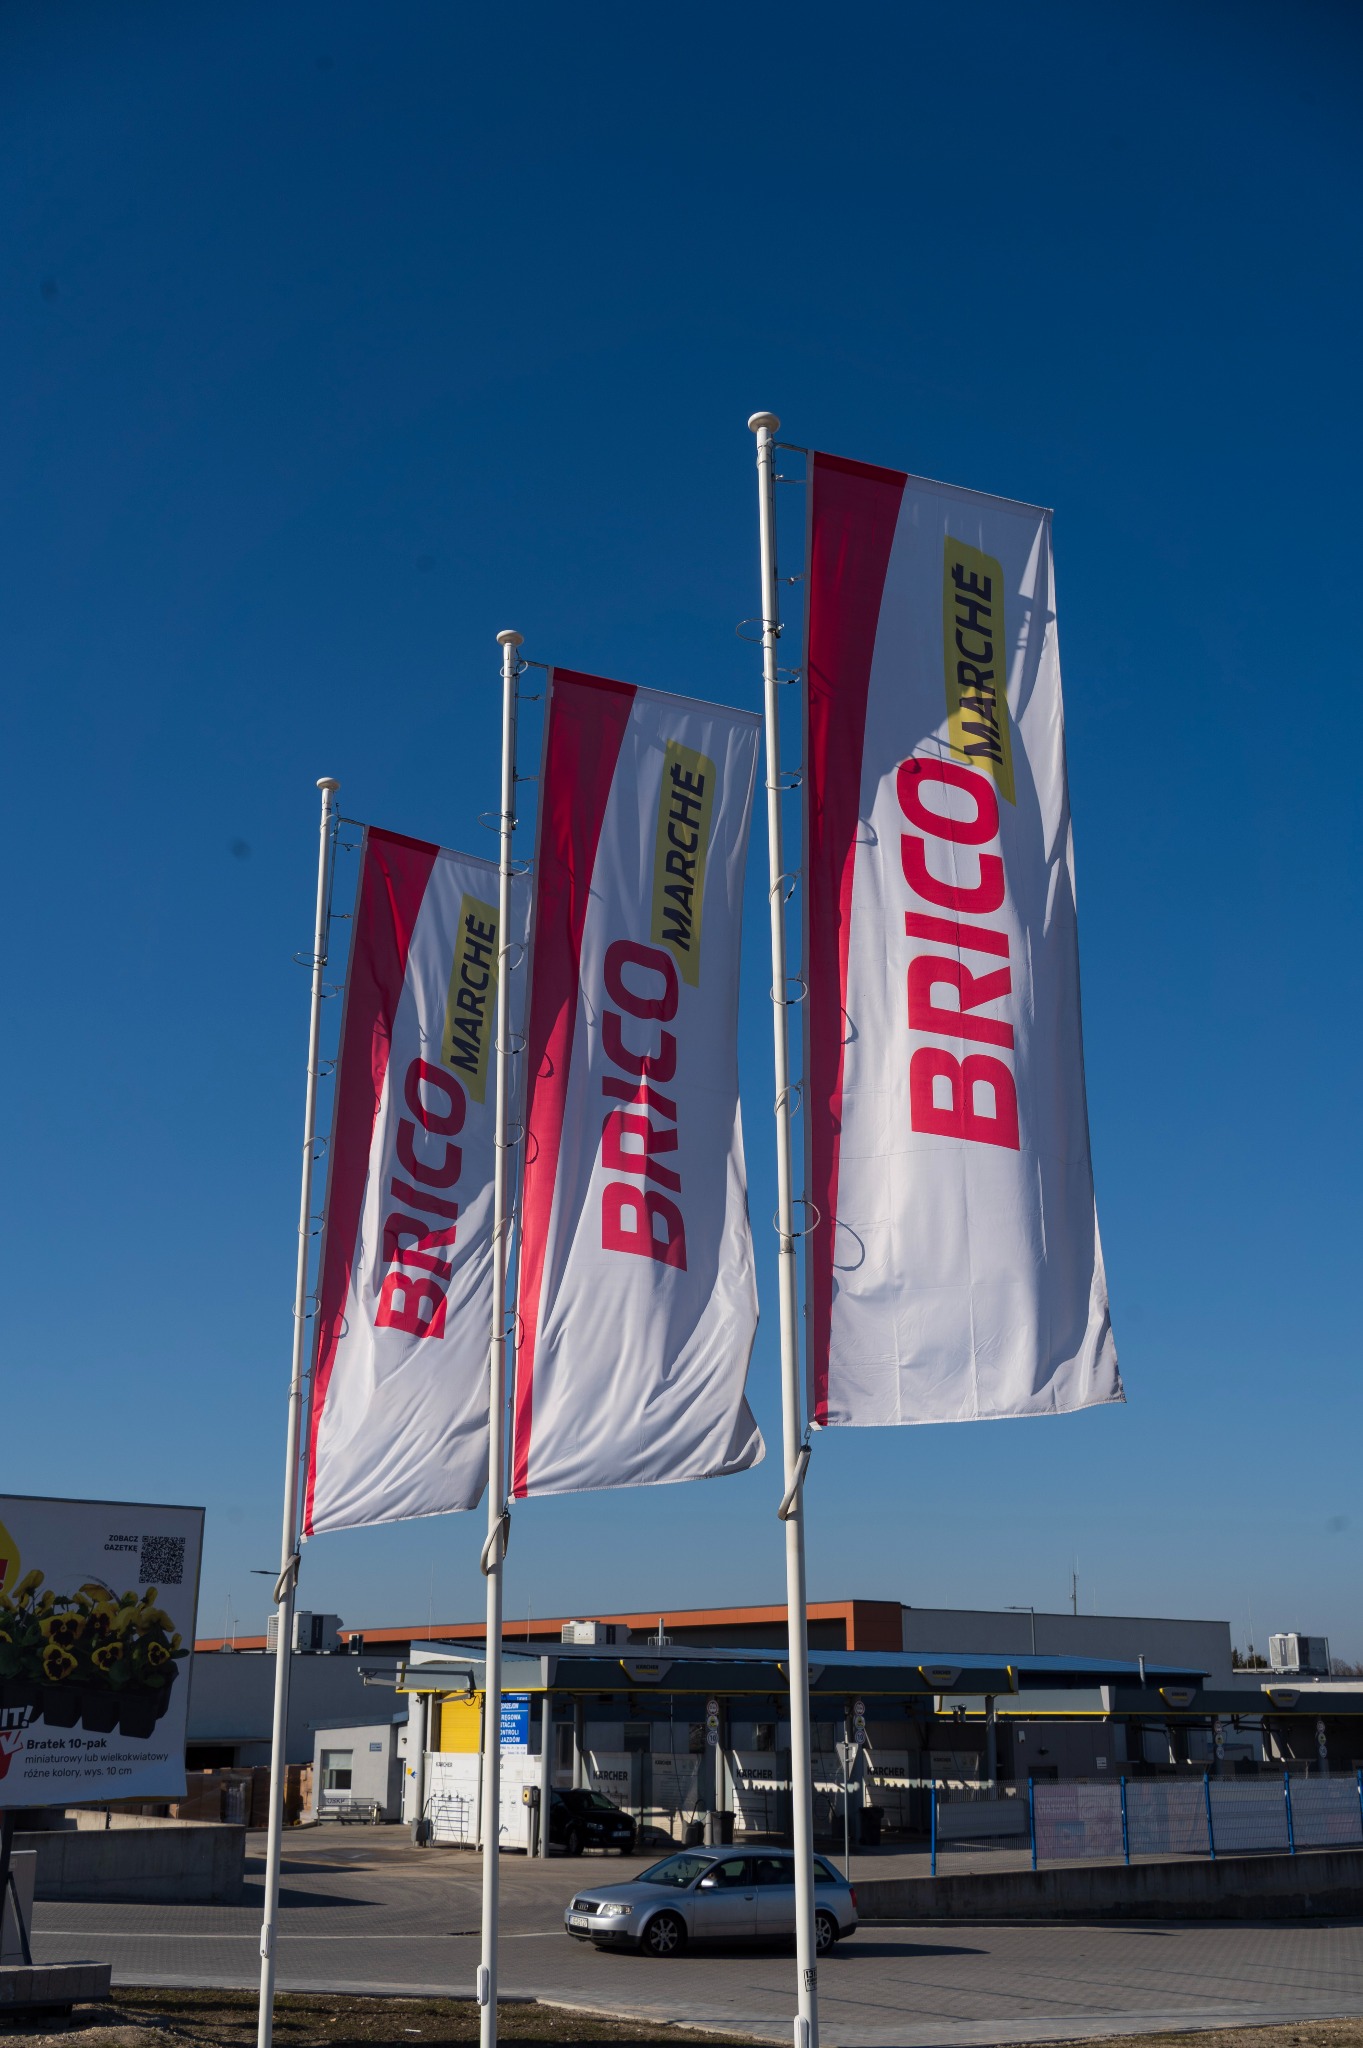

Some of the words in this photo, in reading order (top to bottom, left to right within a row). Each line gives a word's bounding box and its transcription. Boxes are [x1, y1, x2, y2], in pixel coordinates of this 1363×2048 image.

[950, 563, 1003, 767] MARCHÉ
[661, 762, 705, 952] MARCHÉ
[896, 757, 1020, 1151] BRICO
[449, 913, 497, 1075] MARCHÉ
[602, 939, 688, 1272] BRICO
[374, 1057, 467, 1340] BRICO
[108, 1534, 139, 1543] ZOBACZ
[104, 1543, 138, 1553] GAZETKĘ
[0, 1704, 34, 1728] IT!
[500, 1714, 522, 1722] RĘGOWA
[26, 1739, 66, 1750] Bratek
[68, 1738, 107, 1750] 10-pak
[25, 1754, 83, 1764] miniaturowy
[84, 1754, 99, 1762] lub
[100, 1752, 169, 1762] wielkokwiatowy
[23, 1768, 50, 1778] różne
[52, 1767, 82, 1778] kolory,
[84, 1768, 104, 1777] wys.
[106, 1767, 117, 1775] 10
[736, 1768, 773, 1779] KÄRCHER
[867, 1766, 905, 1777] KÄRCHER
